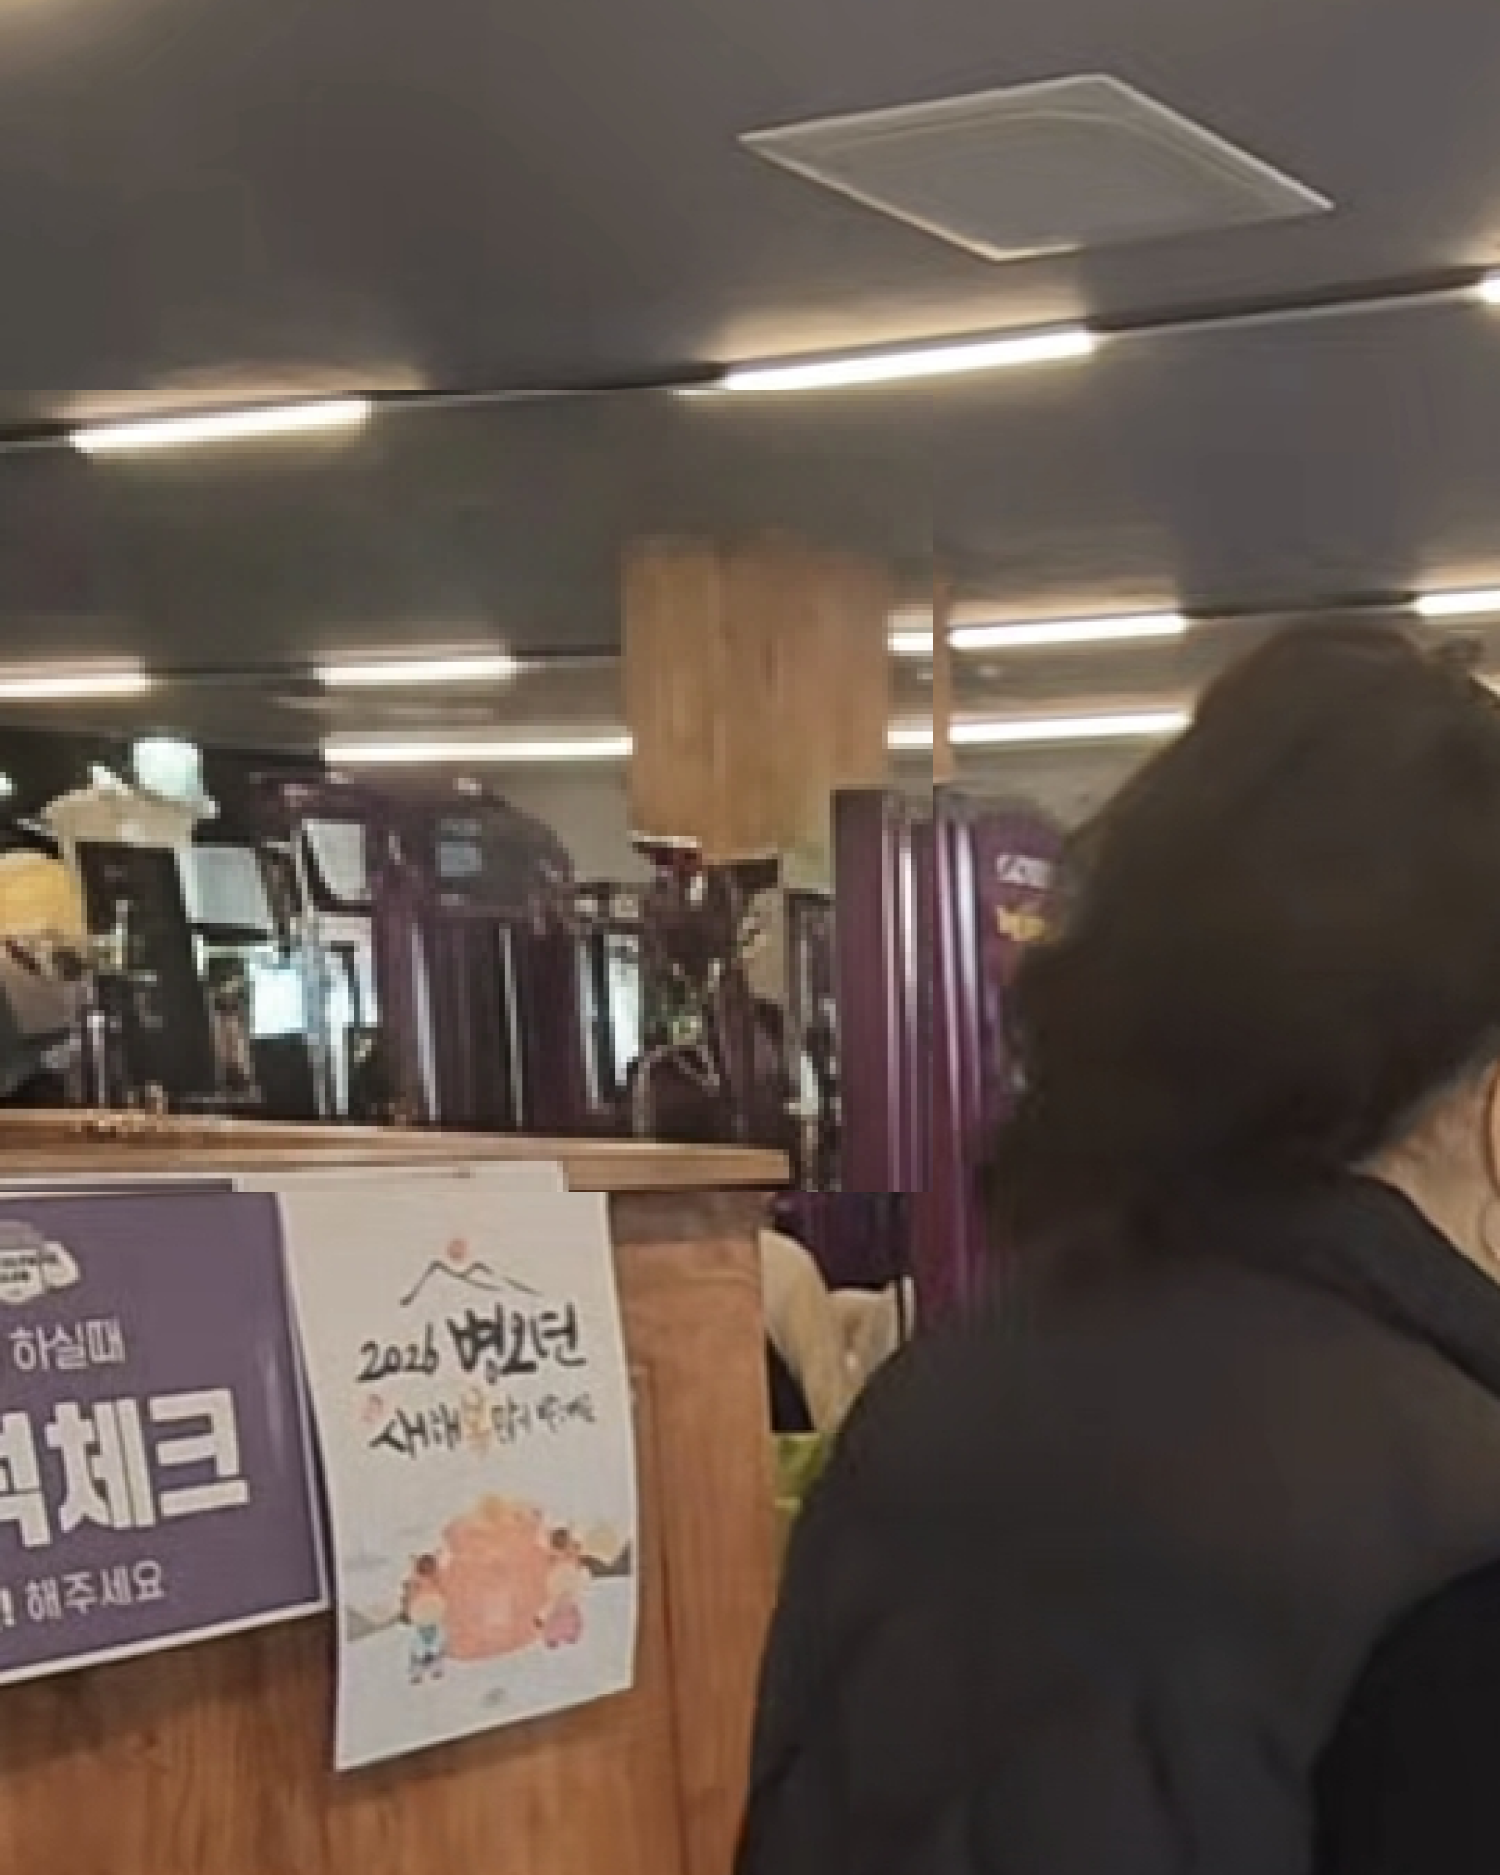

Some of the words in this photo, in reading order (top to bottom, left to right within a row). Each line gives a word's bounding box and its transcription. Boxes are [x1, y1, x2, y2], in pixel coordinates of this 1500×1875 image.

[9, 1317, 127, 1373] 하실때
[356, 1321, 440, 1383] 2026
[25, 1559, 166, 1623] 해주세요
